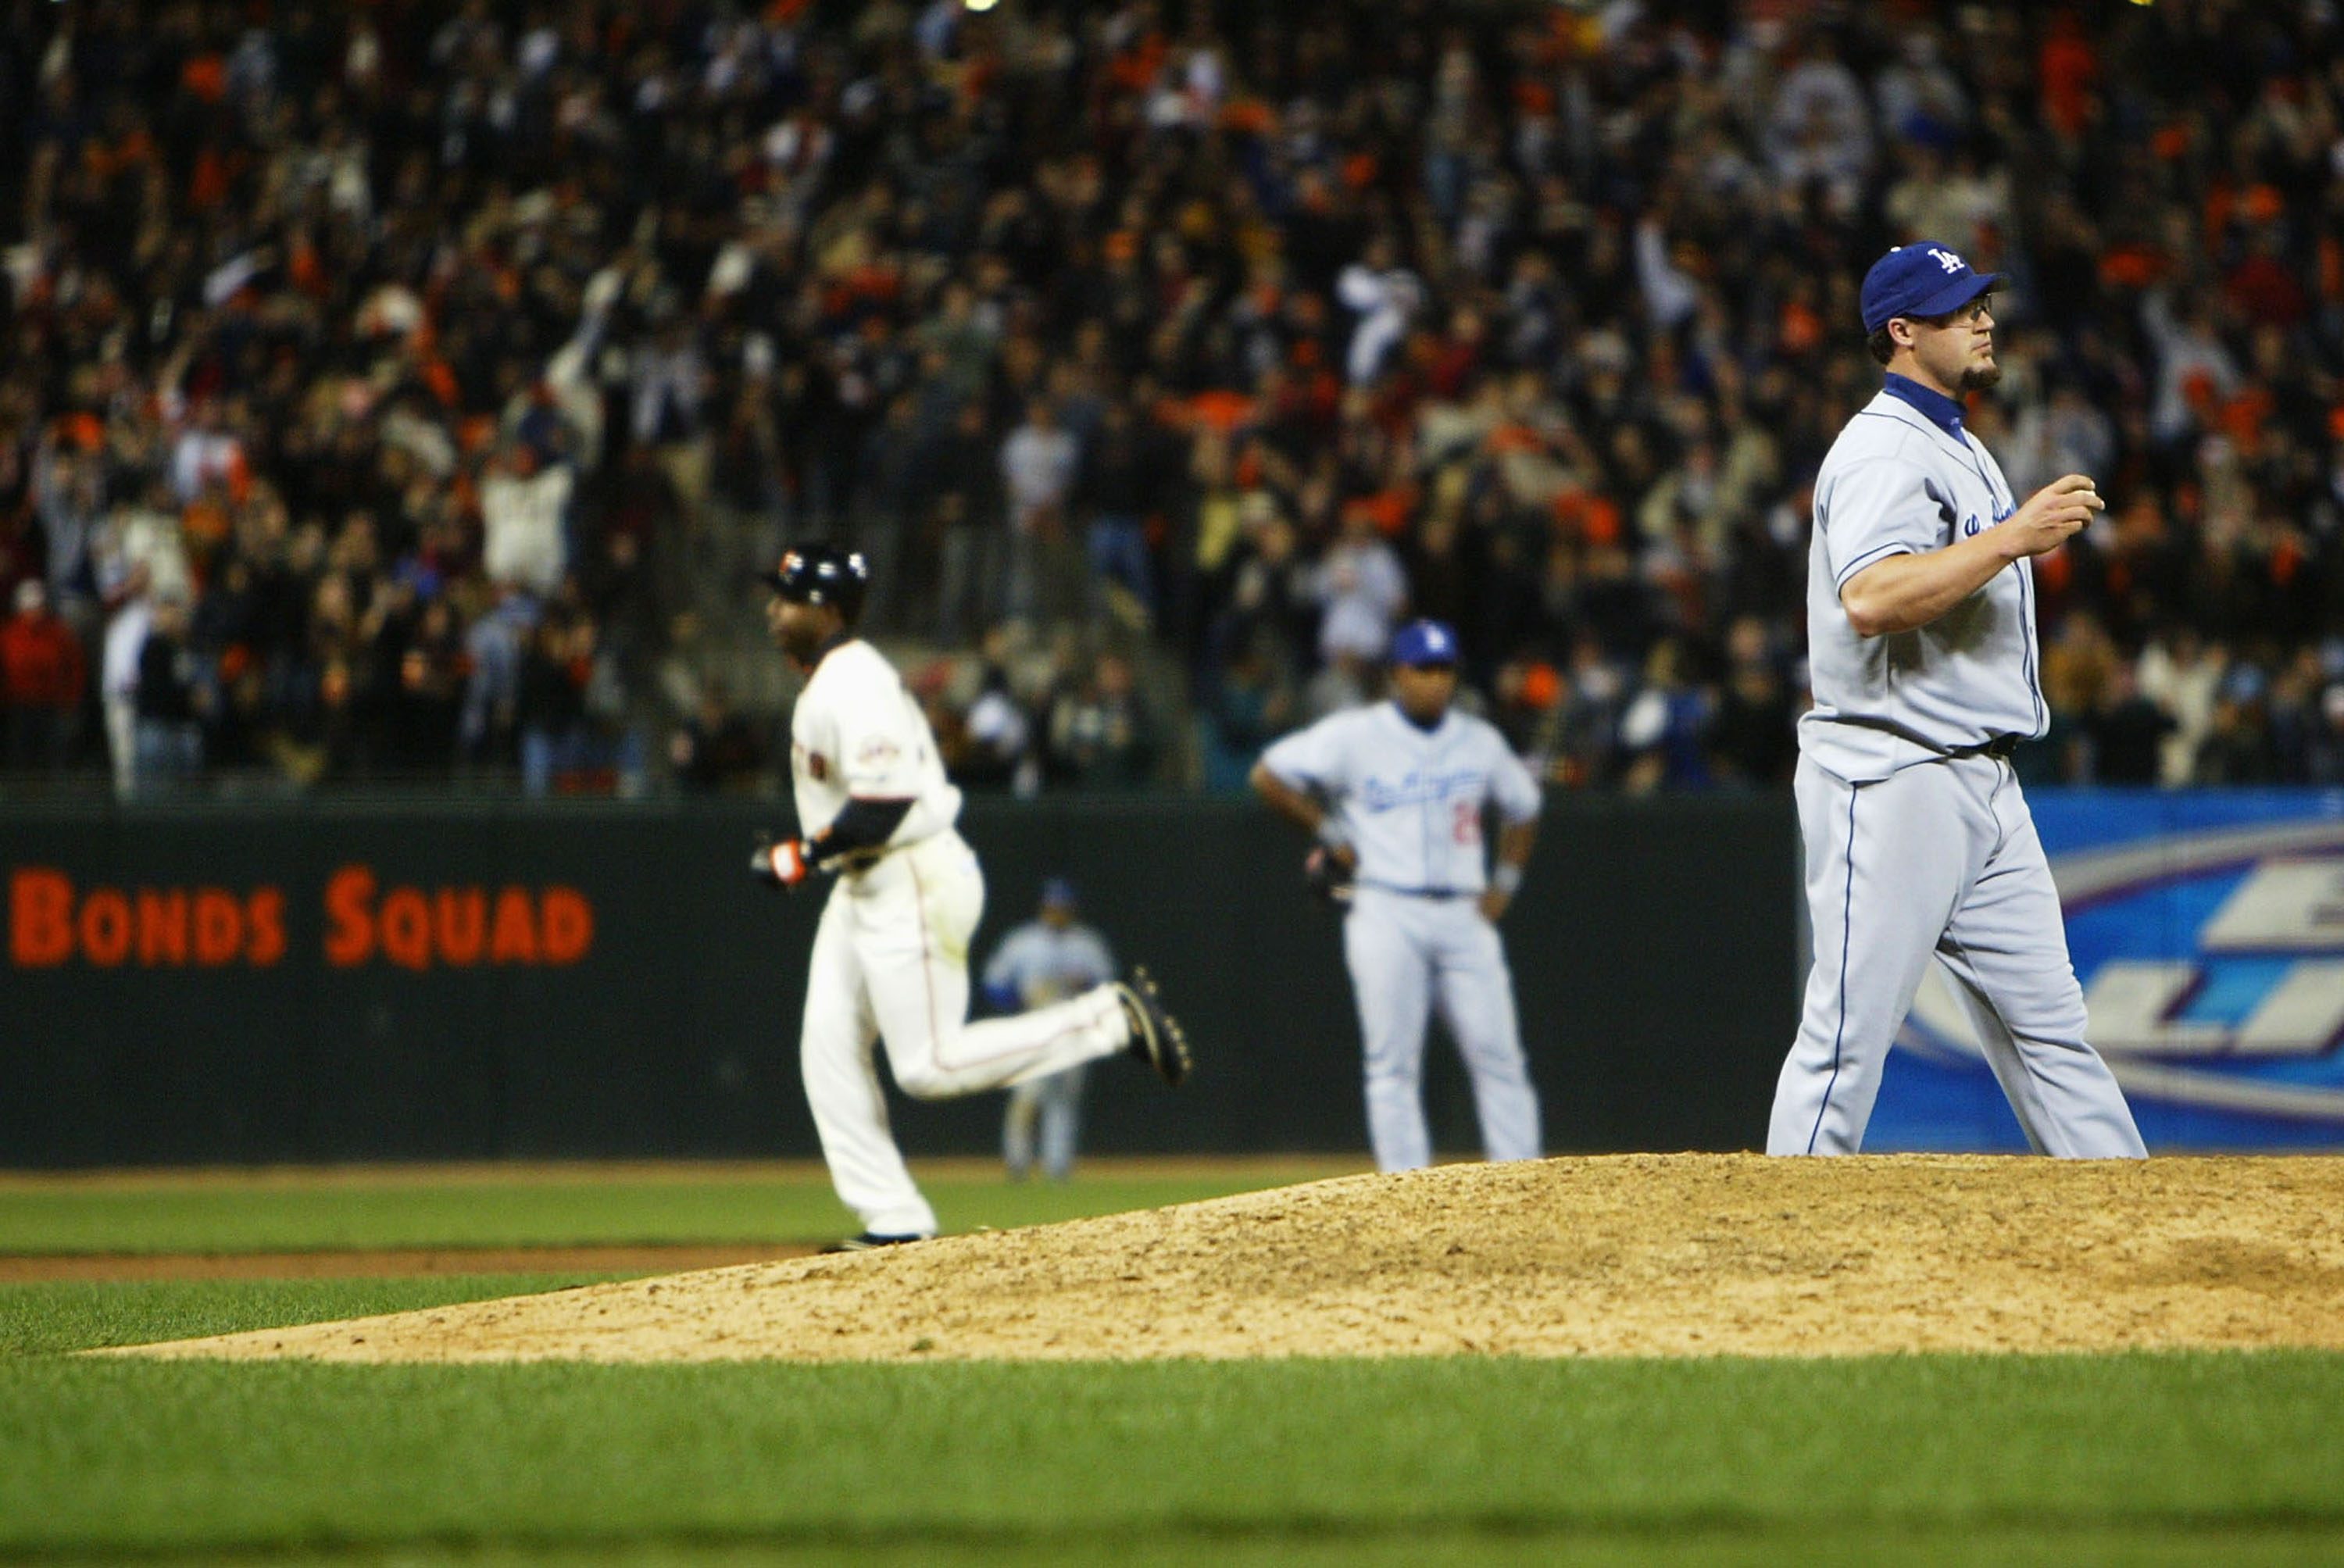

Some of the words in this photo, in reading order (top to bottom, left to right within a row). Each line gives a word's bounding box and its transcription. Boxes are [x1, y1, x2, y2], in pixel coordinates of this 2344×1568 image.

[1927, 248, 1965, 274] LA
[10, 869, 285, 965] BONDS
[324, 865, 592, 970] SQUAD
